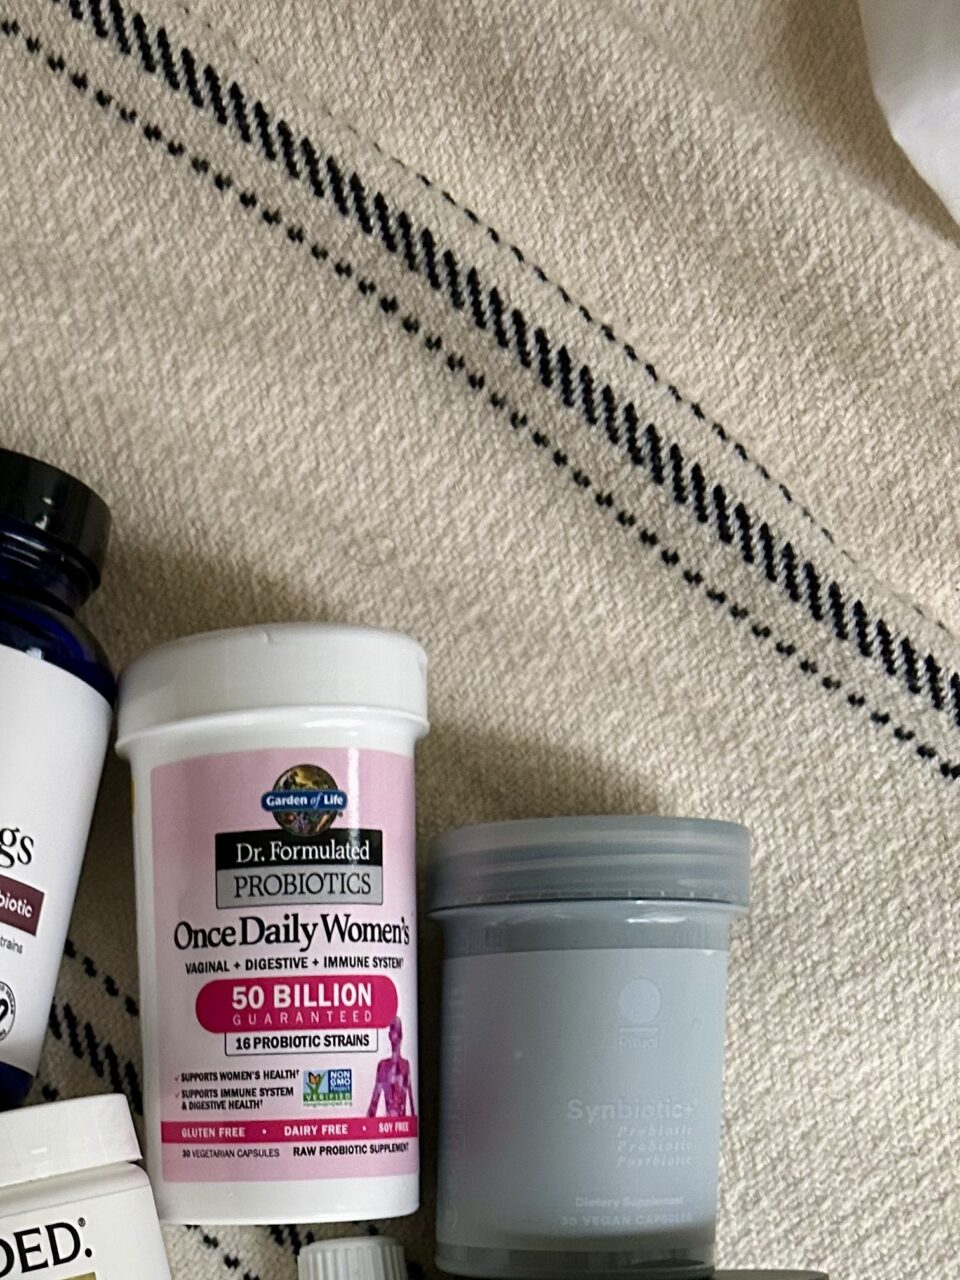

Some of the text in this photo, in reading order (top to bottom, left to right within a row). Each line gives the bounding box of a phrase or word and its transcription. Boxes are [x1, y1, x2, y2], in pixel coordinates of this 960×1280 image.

[265, 793, 344, 808] Garden of Life
[236, 839, 370, 863] Dr. Formulated
[233, 872, 371, 898] PROBIOTICS
[173, 913, 410, 952] Once Daily Women's
[185, 961, 230, 975] VAGINAL
[233, 961, 242, 971] +
[245, 957, 309, 971] DIGESTIVE
[312, 958, 320, 968] +
[323, 956, 370, 969] IMMUNE
[232, 983, 372, 1010] 50 BILLION
[232, 1010, 372, 1026] GUARANTEED
[235, 1034, 370, 1050] 16 PROBIOTIC STRAINS
[180, 1072, 218, 1083] SUPPORTS
[219, 1070, 261, 1081] WOMEN'S
[330, 1070, 350, 1079] NON
[330, 1078, 350, 1086] GMO
[181, 1086, 294, 1100] SUPPORTS IMMUNE SYSTEM
[181, 1101, 187, 1111] &
[188, 1100, 227, 1111] DIGESTIVE
[181, 1121, 410, 1139] GLUTEN FREE DAIRY FREE SOY FREE
[191, 1148, 236, 1159] VEGETARIAN
[236, 1148, 280, 1158] CAPSULES
[293, 1143, 410, 1157] RAW PROBIOTIC SUPPLEMENT
[582, 1215, 632, 1226] VEGAN
